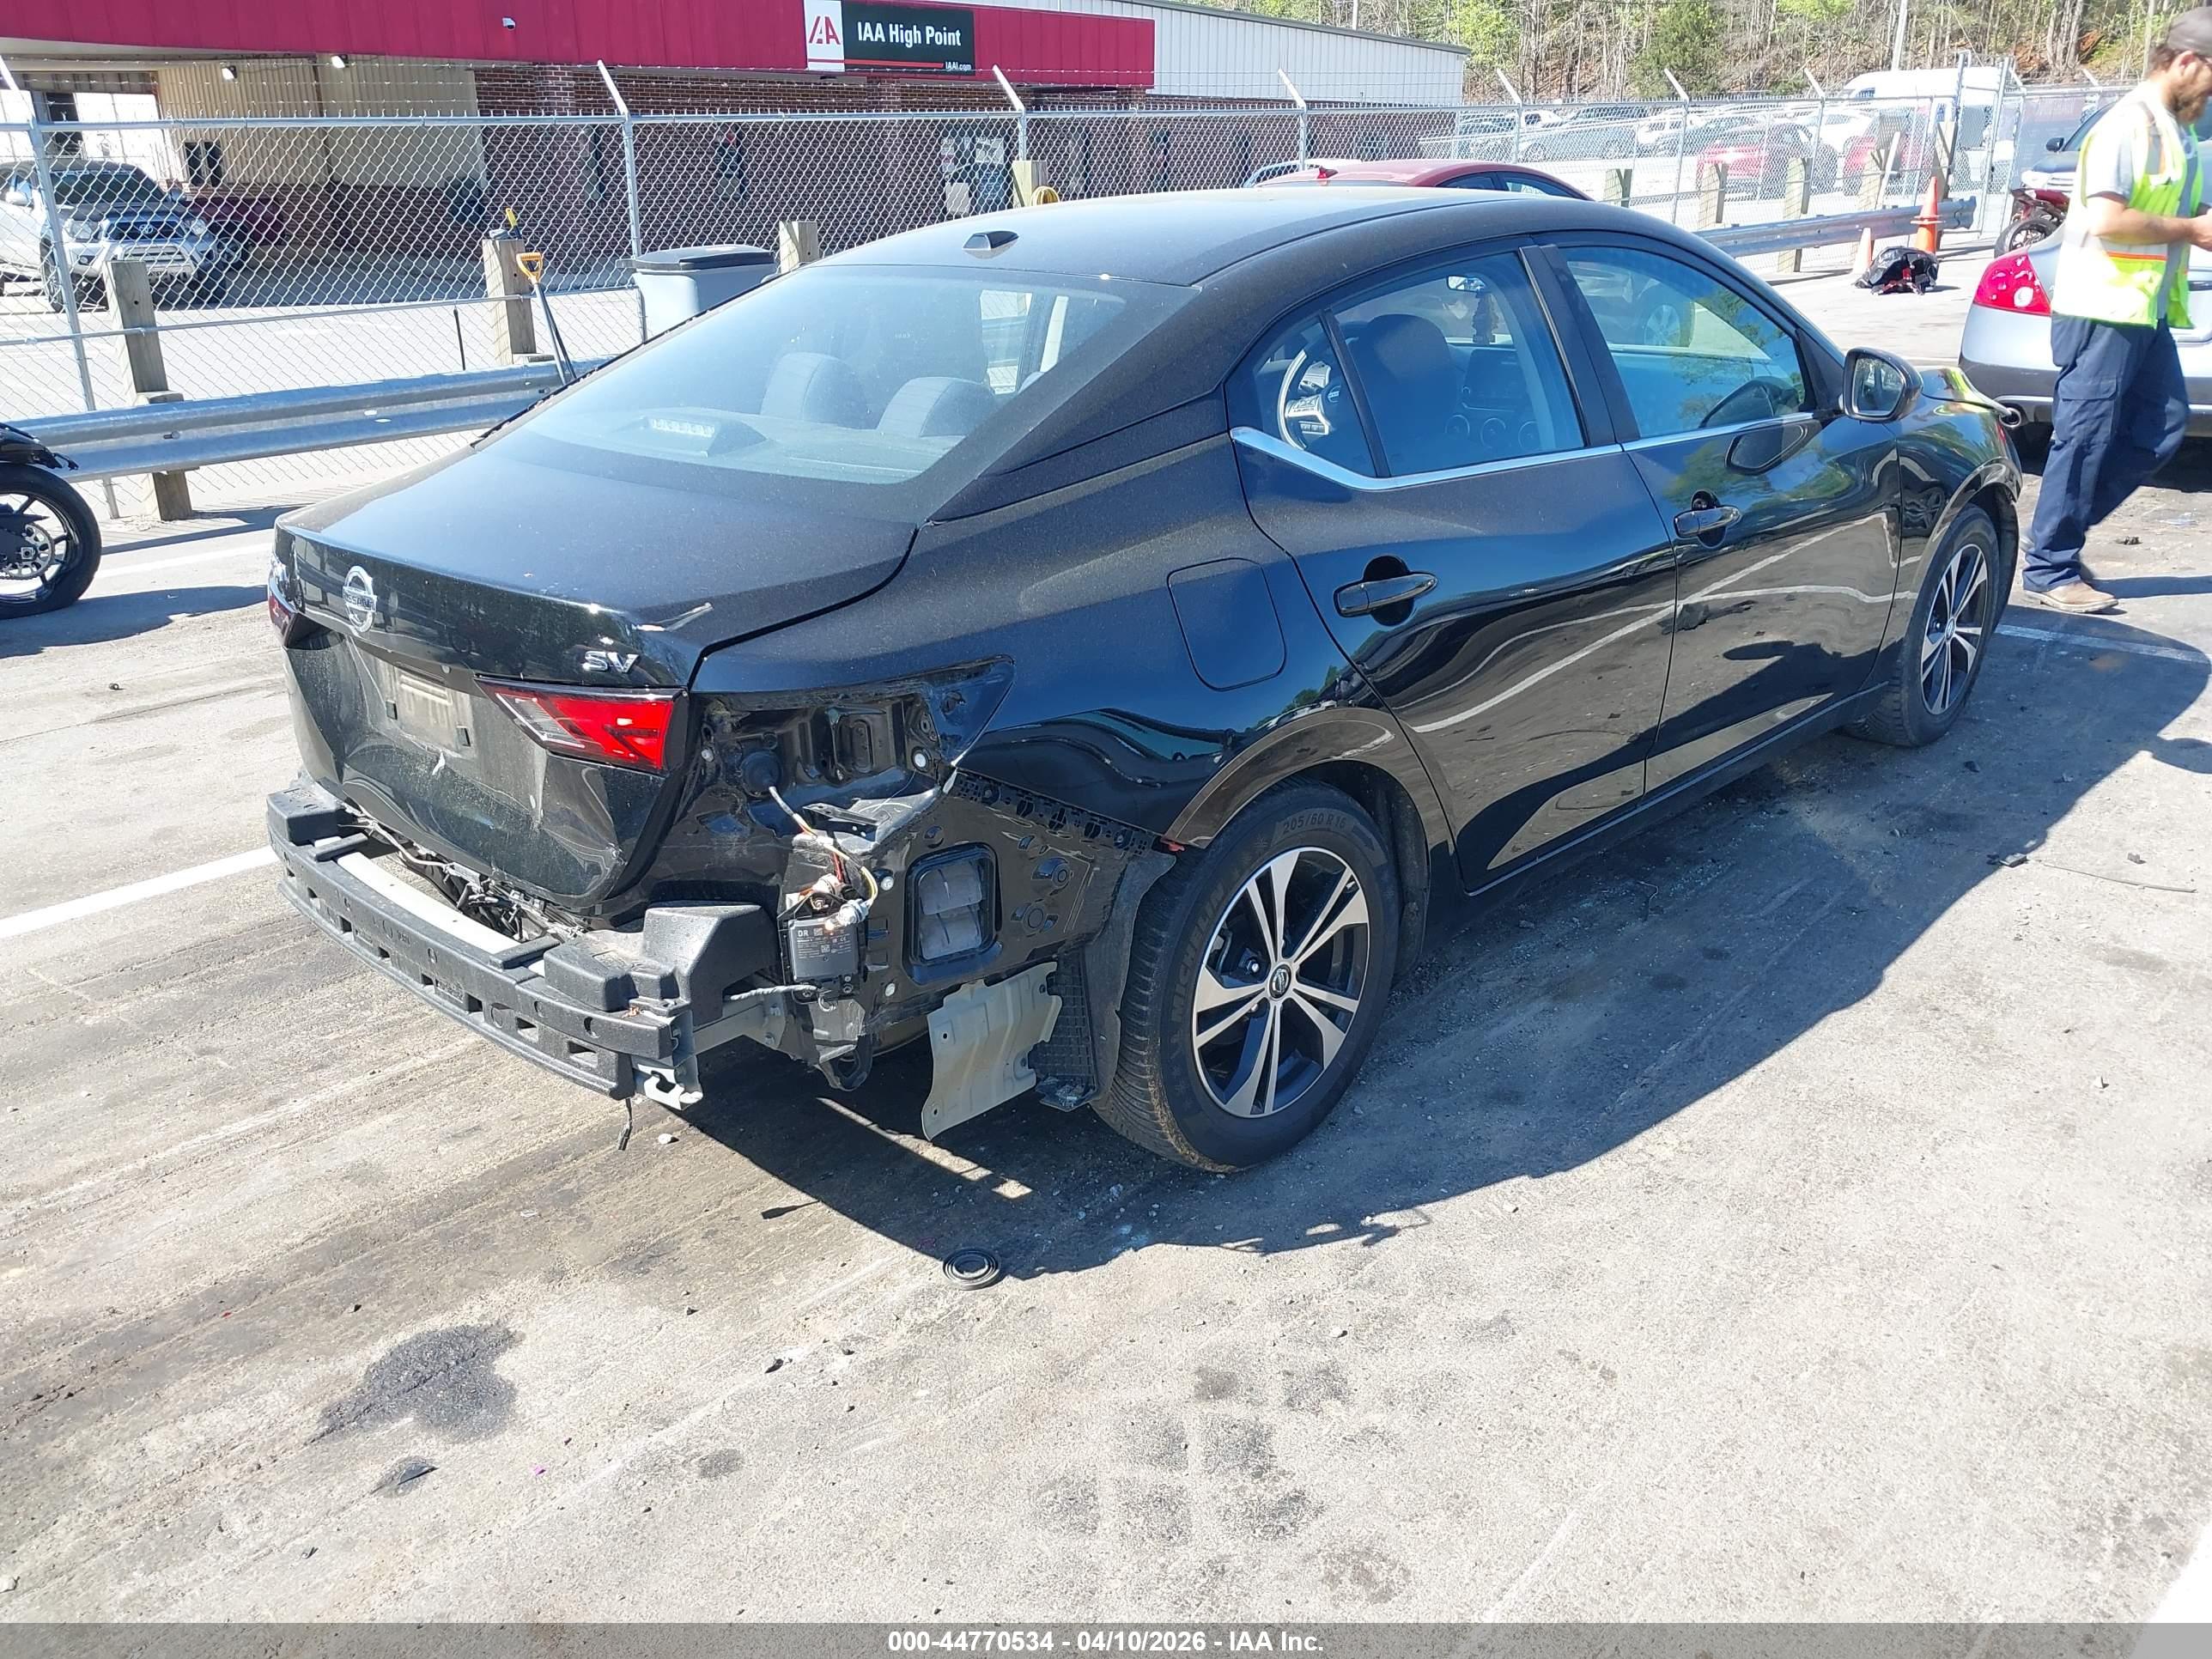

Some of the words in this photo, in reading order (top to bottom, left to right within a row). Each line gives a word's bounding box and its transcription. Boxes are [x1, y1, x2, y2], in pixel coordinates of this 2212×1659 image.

[857, 21, 885, 43] IAA
[889, 23, 921, 48] High
[926, 26, 962, 46] Point
[583, 650, 640, 673] SV
[1283, 813, 1325, 833] 205/60
[1335, 814, 1347, 830] 16
[1170, 880, 1225, 1023] MICHELIN
